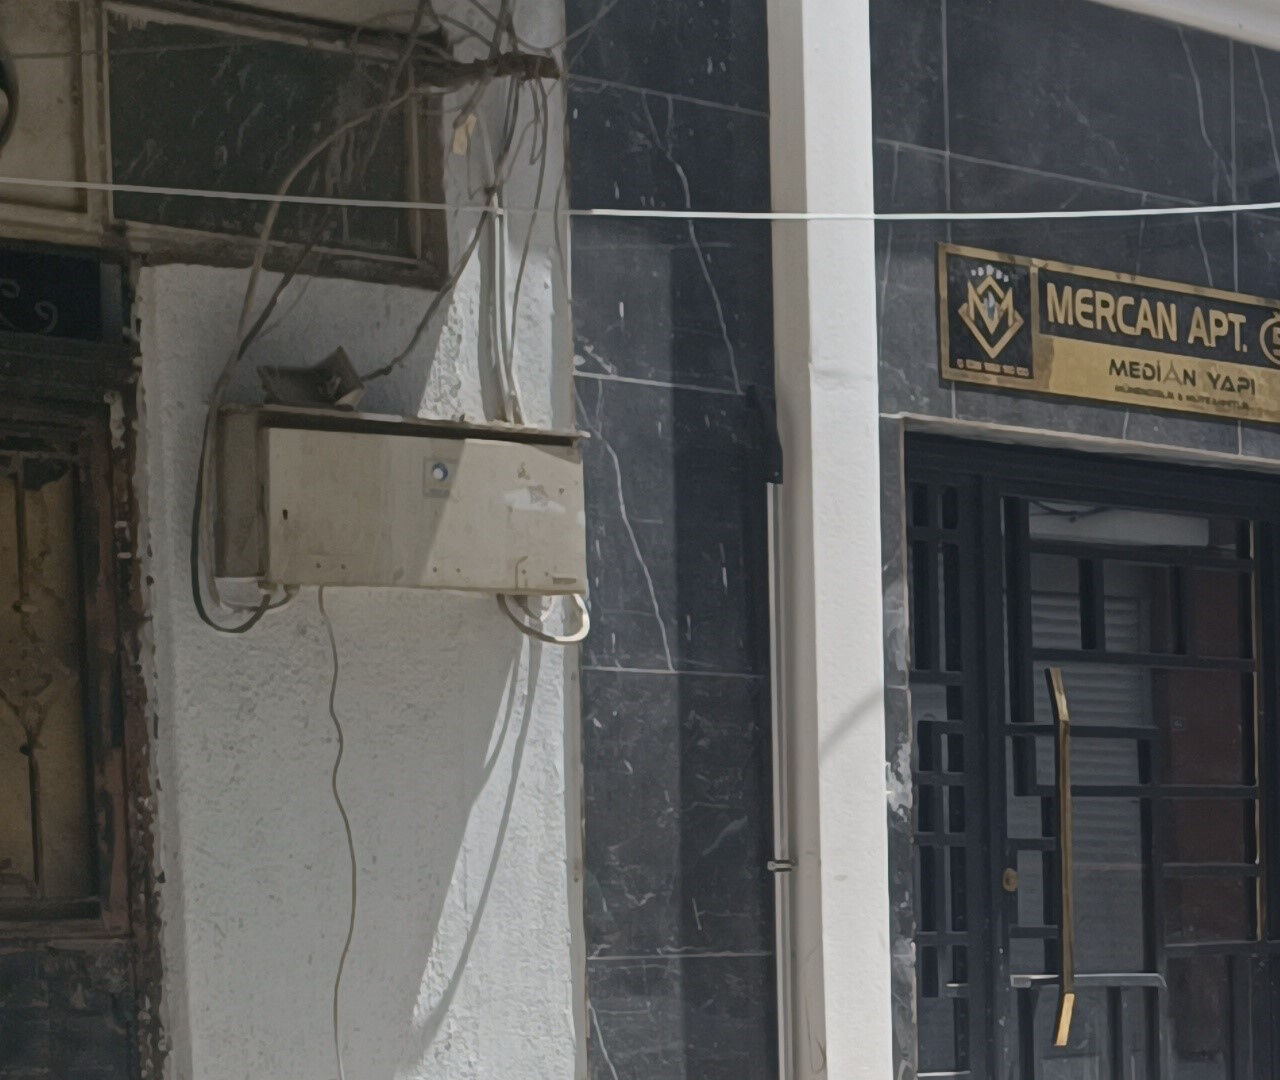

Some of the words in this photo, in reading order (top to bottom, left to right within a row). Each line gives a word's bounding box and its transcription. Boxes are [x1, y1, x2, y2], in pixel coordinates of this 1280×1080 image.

[1046, 282, 1178, 343] MERCAN
[1187, 305, 1249, 353] APT.
[1206, 371, 1255, 395] YAPI
